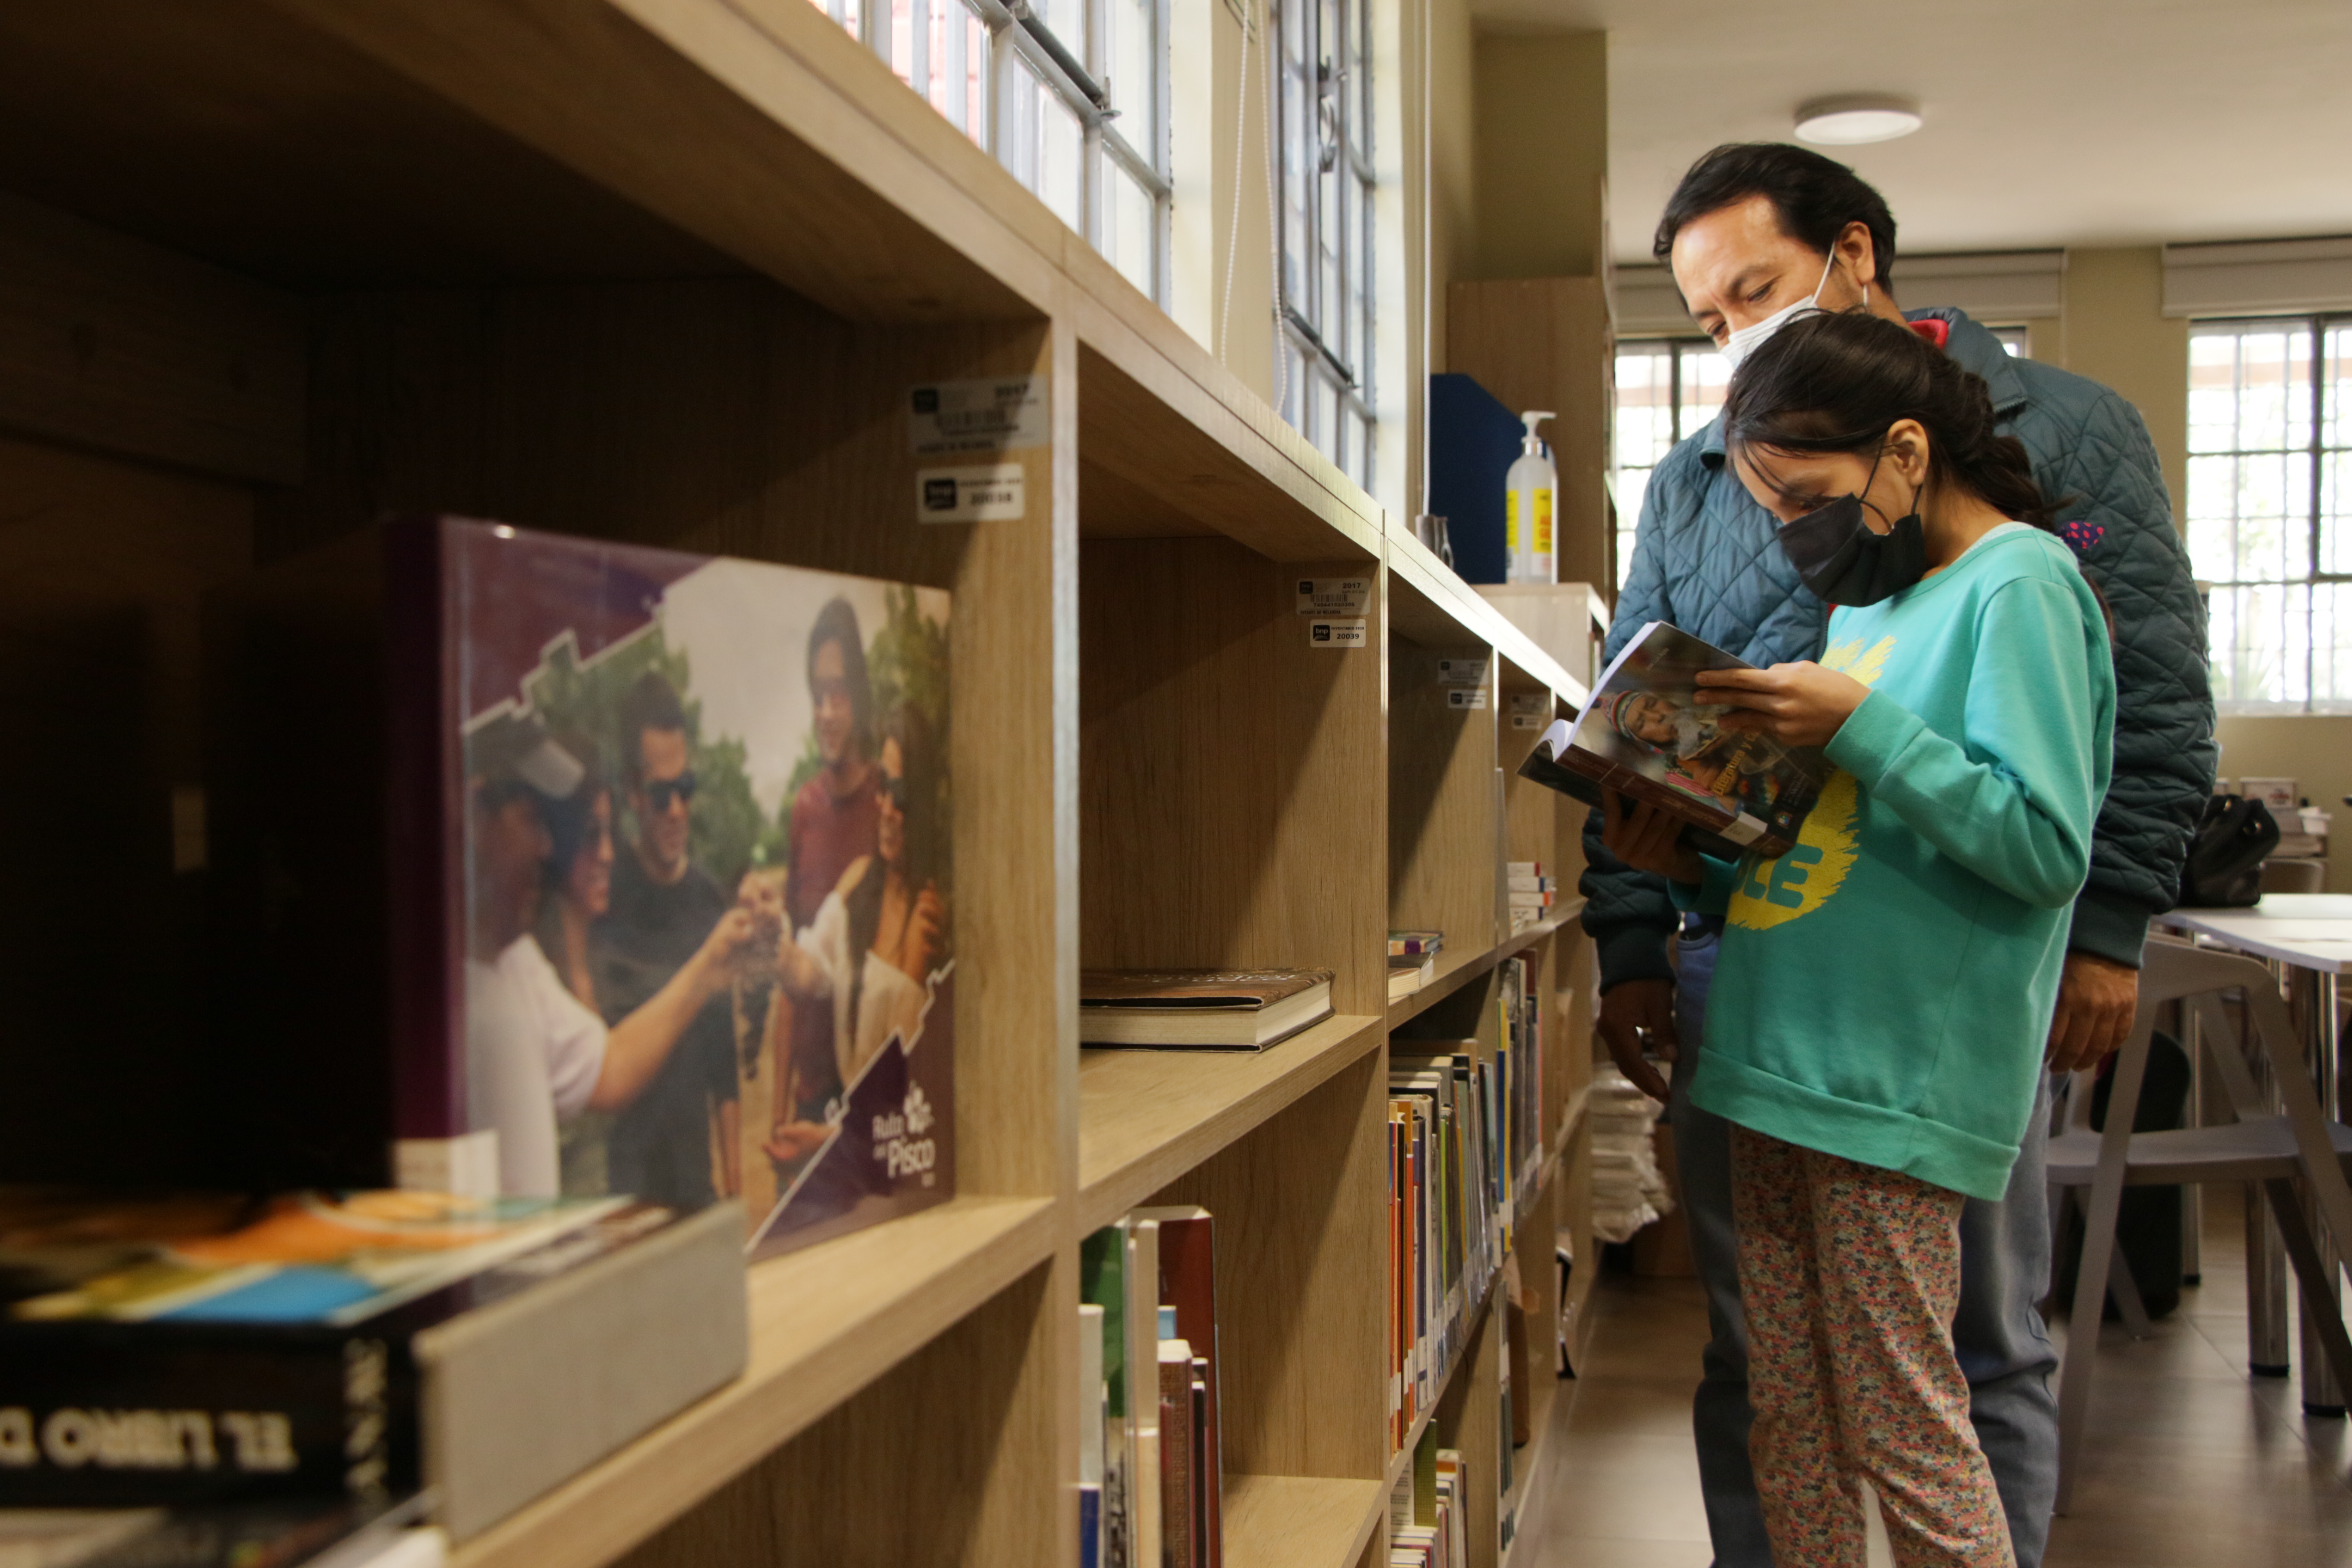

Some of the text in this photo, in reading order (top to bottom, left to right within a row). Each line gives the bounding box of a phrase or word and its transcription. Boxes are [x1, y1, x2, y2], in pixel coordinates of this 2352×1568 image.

[1712, 750, 1745, 796] Literatura
[873, 1113, 903, 1139] Ruta
[888, 1136, 935, 1178] Pisco
[221, 1410, 297, 1473] EL
